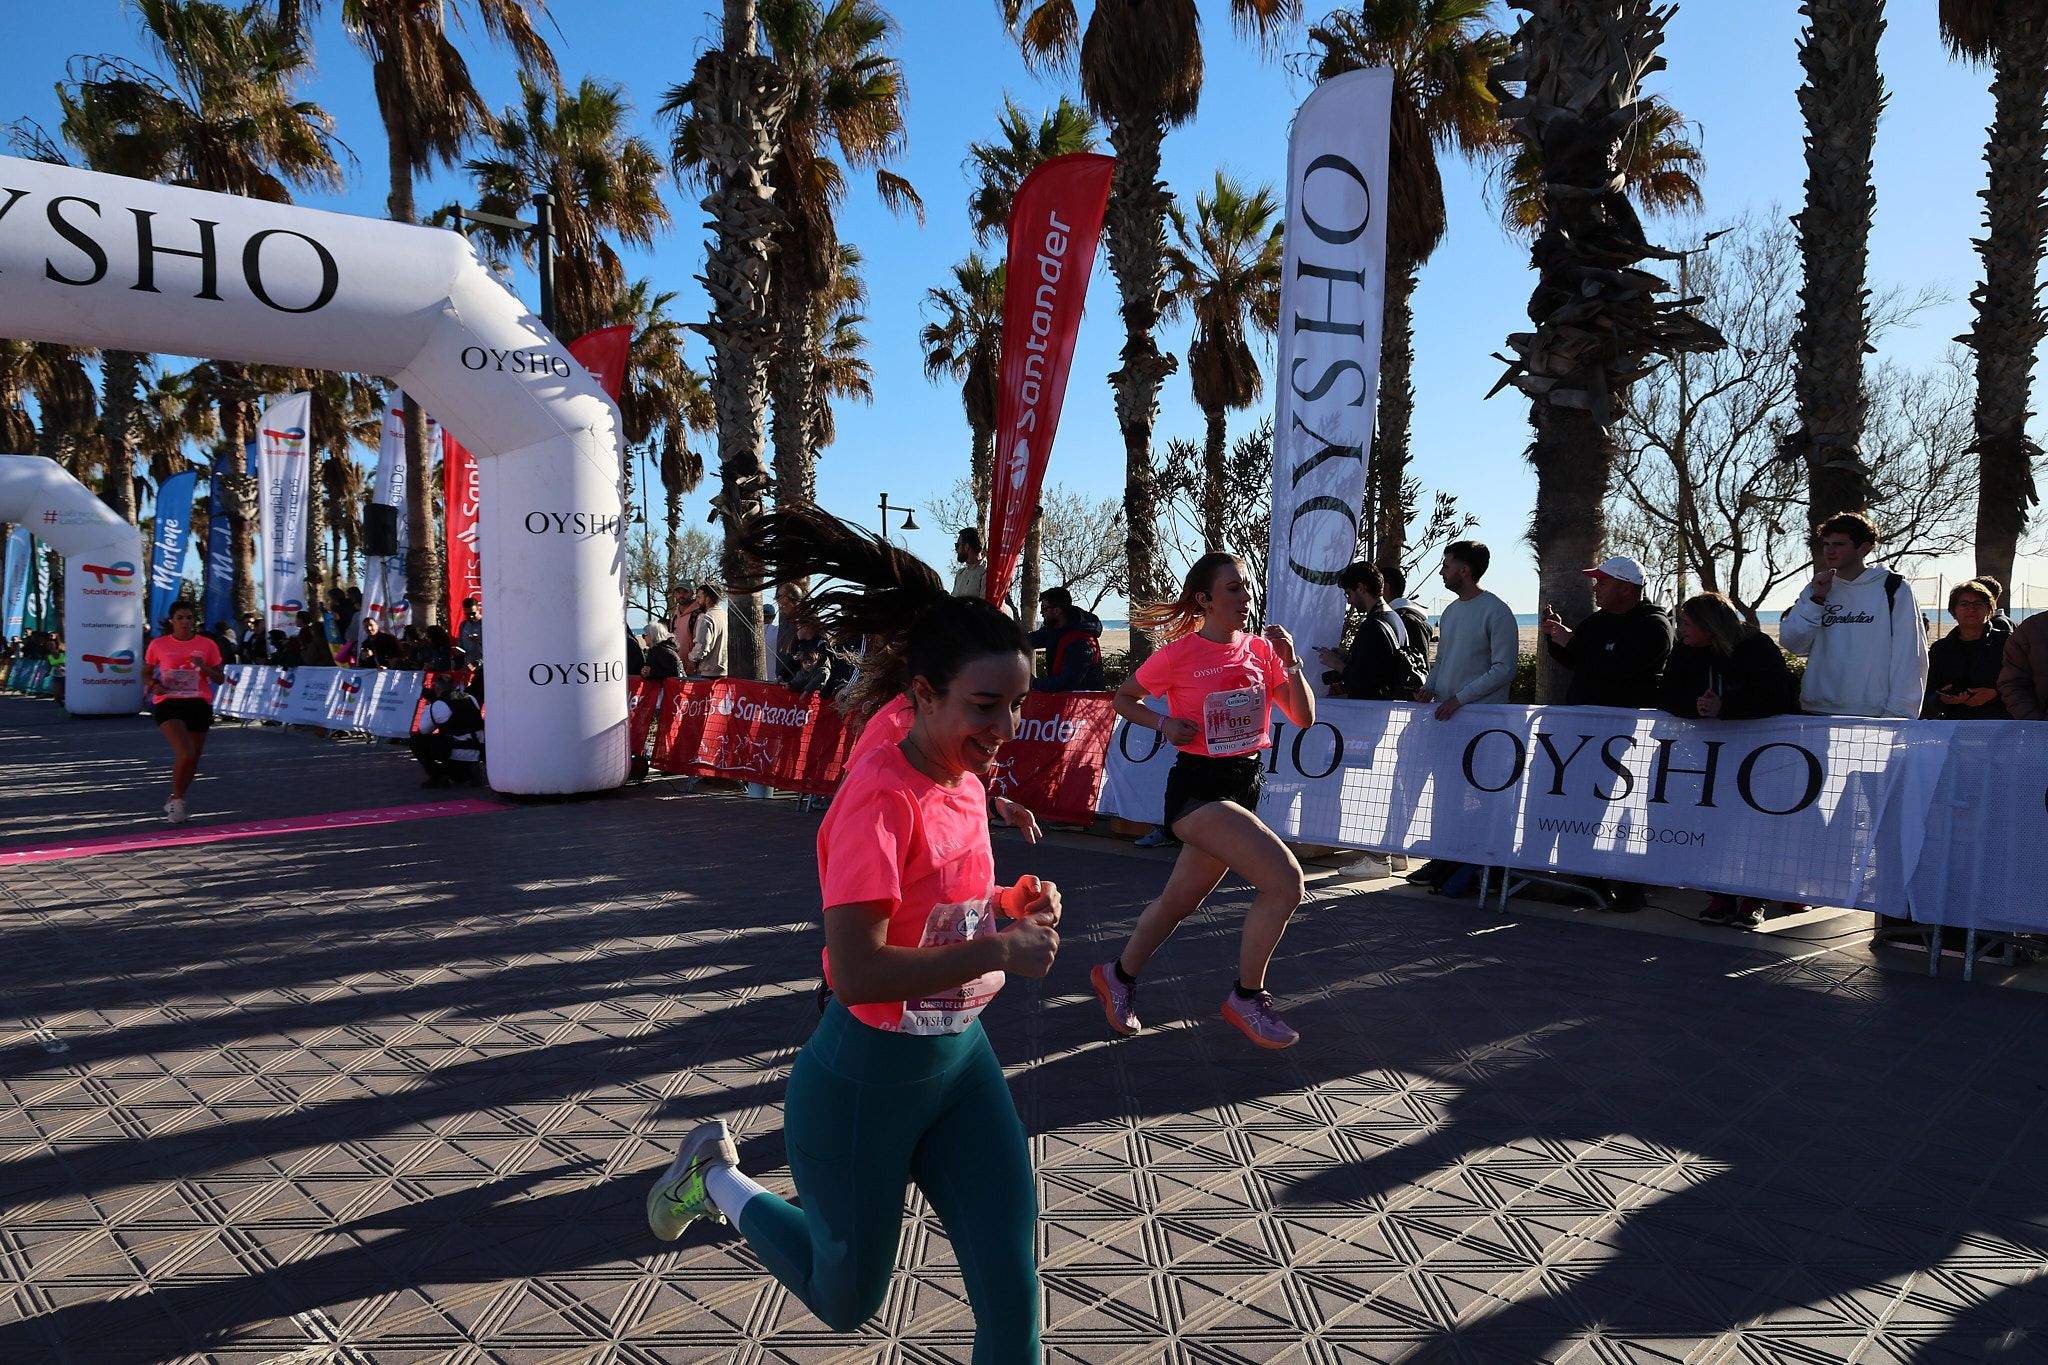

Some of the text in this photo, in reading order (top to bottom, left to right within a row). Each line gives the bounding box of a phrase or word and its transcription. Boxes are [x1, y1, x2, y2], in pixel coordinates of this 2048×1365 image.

[1018, 209, 1072, 432] Santander
[461, 346, 571, 378] OYSHO
[1288, 153, 1370, 586] OYSHO
[525, 511, 621, 536] OYSHO
[153, 518, 182, 591] Marlene
[528, 660, 624, 686] OYSHO
[1193, 667, 1223, 678] OYSHO
[735, 696, 814, 727] Santander
[1461, 729, 1823, 815] OYSHO
[1538, 817, 1705, 847] WWW.OYSHO.COM
[916, 1016, 953, 1026] OYSHO
